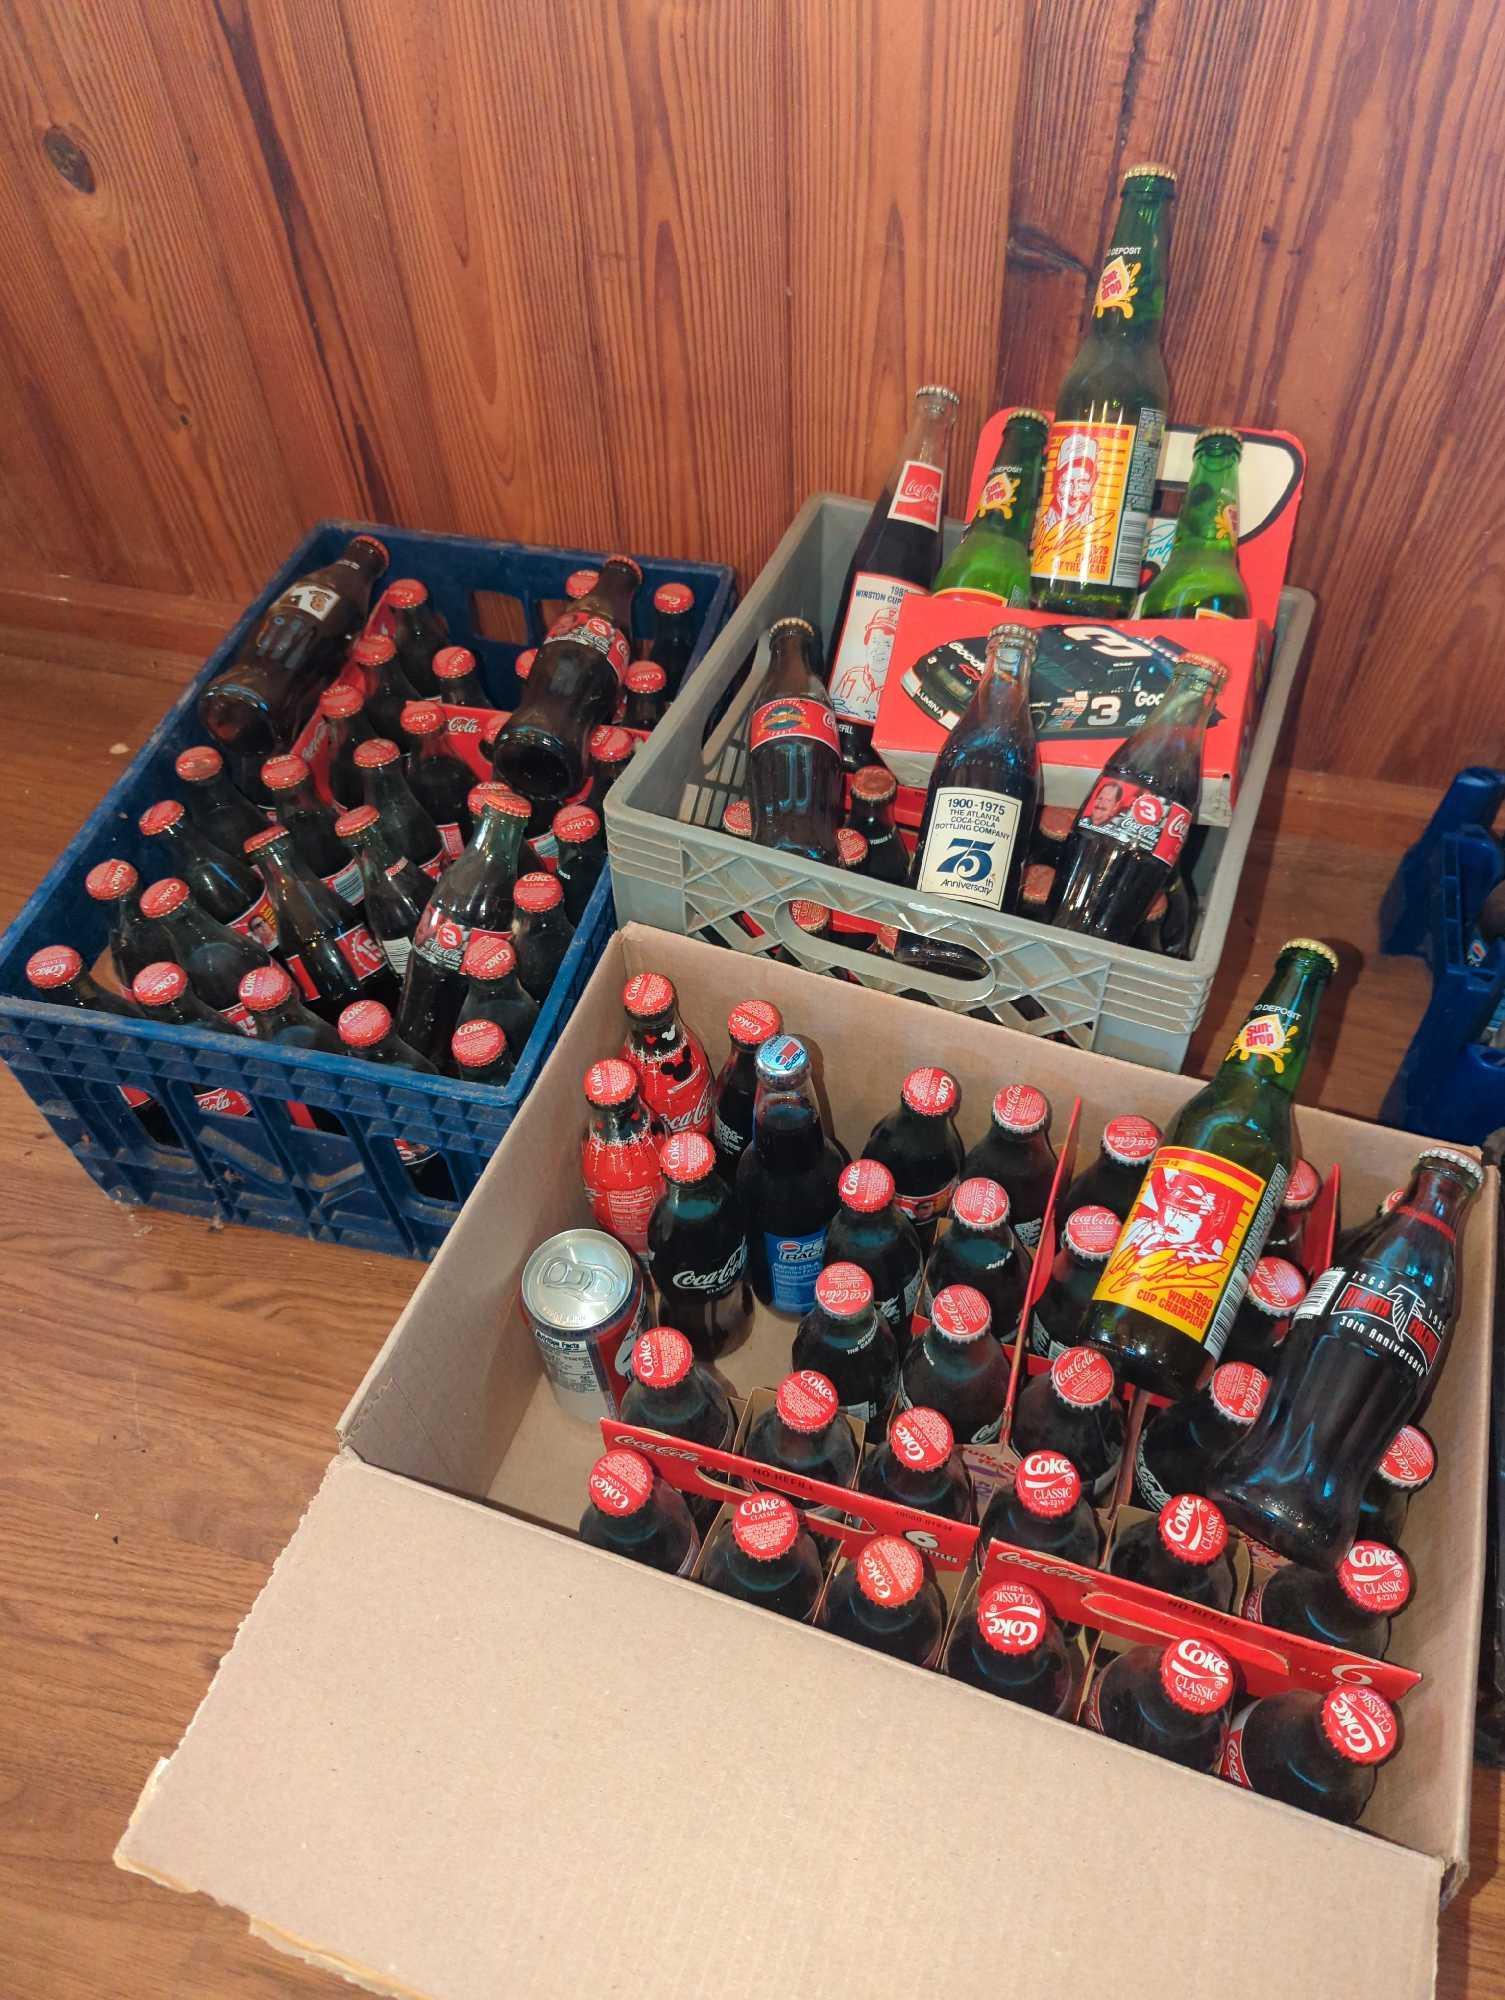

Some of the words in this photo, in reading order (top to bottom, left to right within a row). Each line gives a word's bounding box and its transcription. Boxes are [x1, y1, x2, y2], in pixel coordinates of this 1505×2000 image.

[855, 589, 887, 602] WINSTON
[915, 688, 945, 718] LUMINA
[1087, 695, 1122, 727] 3
[448, 715, 479, 734] Cola
[949, 808, 964, 817] THE
[966, 809, 1001, 823] ATLANTA
[950, 815, 997, 829] COCA-COLA
[1138, 799, 1158, 822] 3
[934, 822, 972, 832] BOTTLING
[972, 825, 1010, 840] COMPANY
[936, 837, 994, 882] 75
[940, 878, 993, 896] Anniversary
[625, 974, 643, 1001] Coke
[456, 1019, 490, 1035] Coke
[732, 1014, 761, 1037] Coke
[1261, 1004, 1302, 1021] DEPOSIT
[591, 1064, 602, 1095] Coke
[934, 1075, 954, 1106] Coke
[667, 1139, 680, 1170] Coke
[841, 1163, 861, 1195] Coke
[1068, 1213, 1115, 1227] Coca-Cola
[1352, 1270, 1385, 1290] 1966
[819, 1288, 871, 1304] Coca-Cola
[1137, 1288, 1158, 1304] CUP
[1158, 1297, 1206, 1330] CHAMPION
[942, 1290, 969, 1335] Coca-Cola
[640, 1340, 654, 1378] Coke
[1339, 1315, 1366, 1334] 30th
[1368, 1327, 1425, 1378] Anniversary
[1055, 1353, 1096, 1386] Coca-Cola
[800, 1370, 833, 1400] Coke
[613, 1435, 699, 1463] Coca-Cola
[895, 1426, 925, 1461] Coke
[1024, 1453, 1073, 1476] Coke
[594, 1476, 630, 1509] Coke
[740, 1495, 779, 1517] Coke
[1033, 1486, 1073, 1500] CLASSIC
[749, 1510, 778, 1521] CLASSIC
[1164, 1495, 1195, 1542] Coke
[1200, 1510, 1220, 1551] CLASSIC
[904, 1529, 939, 1549] 6
[996, 1550, 1096, 1585] Coca-Cola
[1349, 1545, 1398, 1568] Coke
[865, 1558, 892, 1599] Coke
[1363, 1580, 1405, 1594] CLASSIC
[992, 1589, 1034, 1606] CLASSIC
[986, 1617, 1039, 1647] Coke
[1177, 1638, 1230, 1675] Coke
[1174, 1674, 1218, 1704] CLASSIC
[1357, 1688, 1392, 1735] CLASSIC
[1330, 1700, 1373, 1754] Coke
